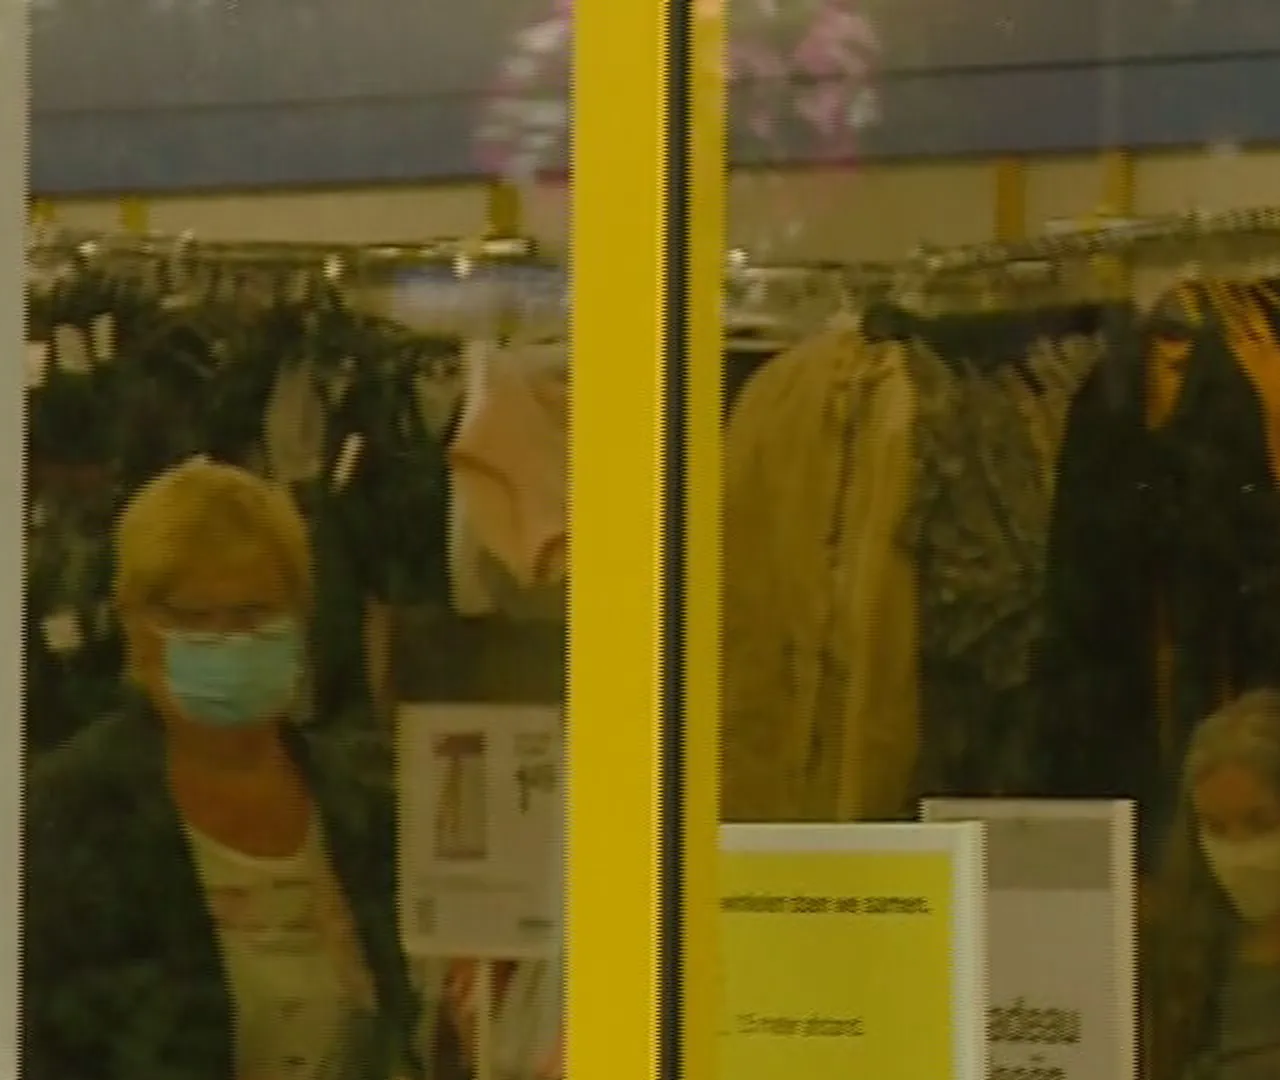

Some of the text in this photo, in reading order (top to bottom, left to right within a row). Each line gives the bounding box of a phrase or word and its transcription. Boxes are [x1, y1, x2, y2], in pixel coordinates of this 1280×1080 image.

[833, 896, 859, 915] we
[864, 895, 931, 915] samen.
[988, 996, 1080, 1044] adeau
